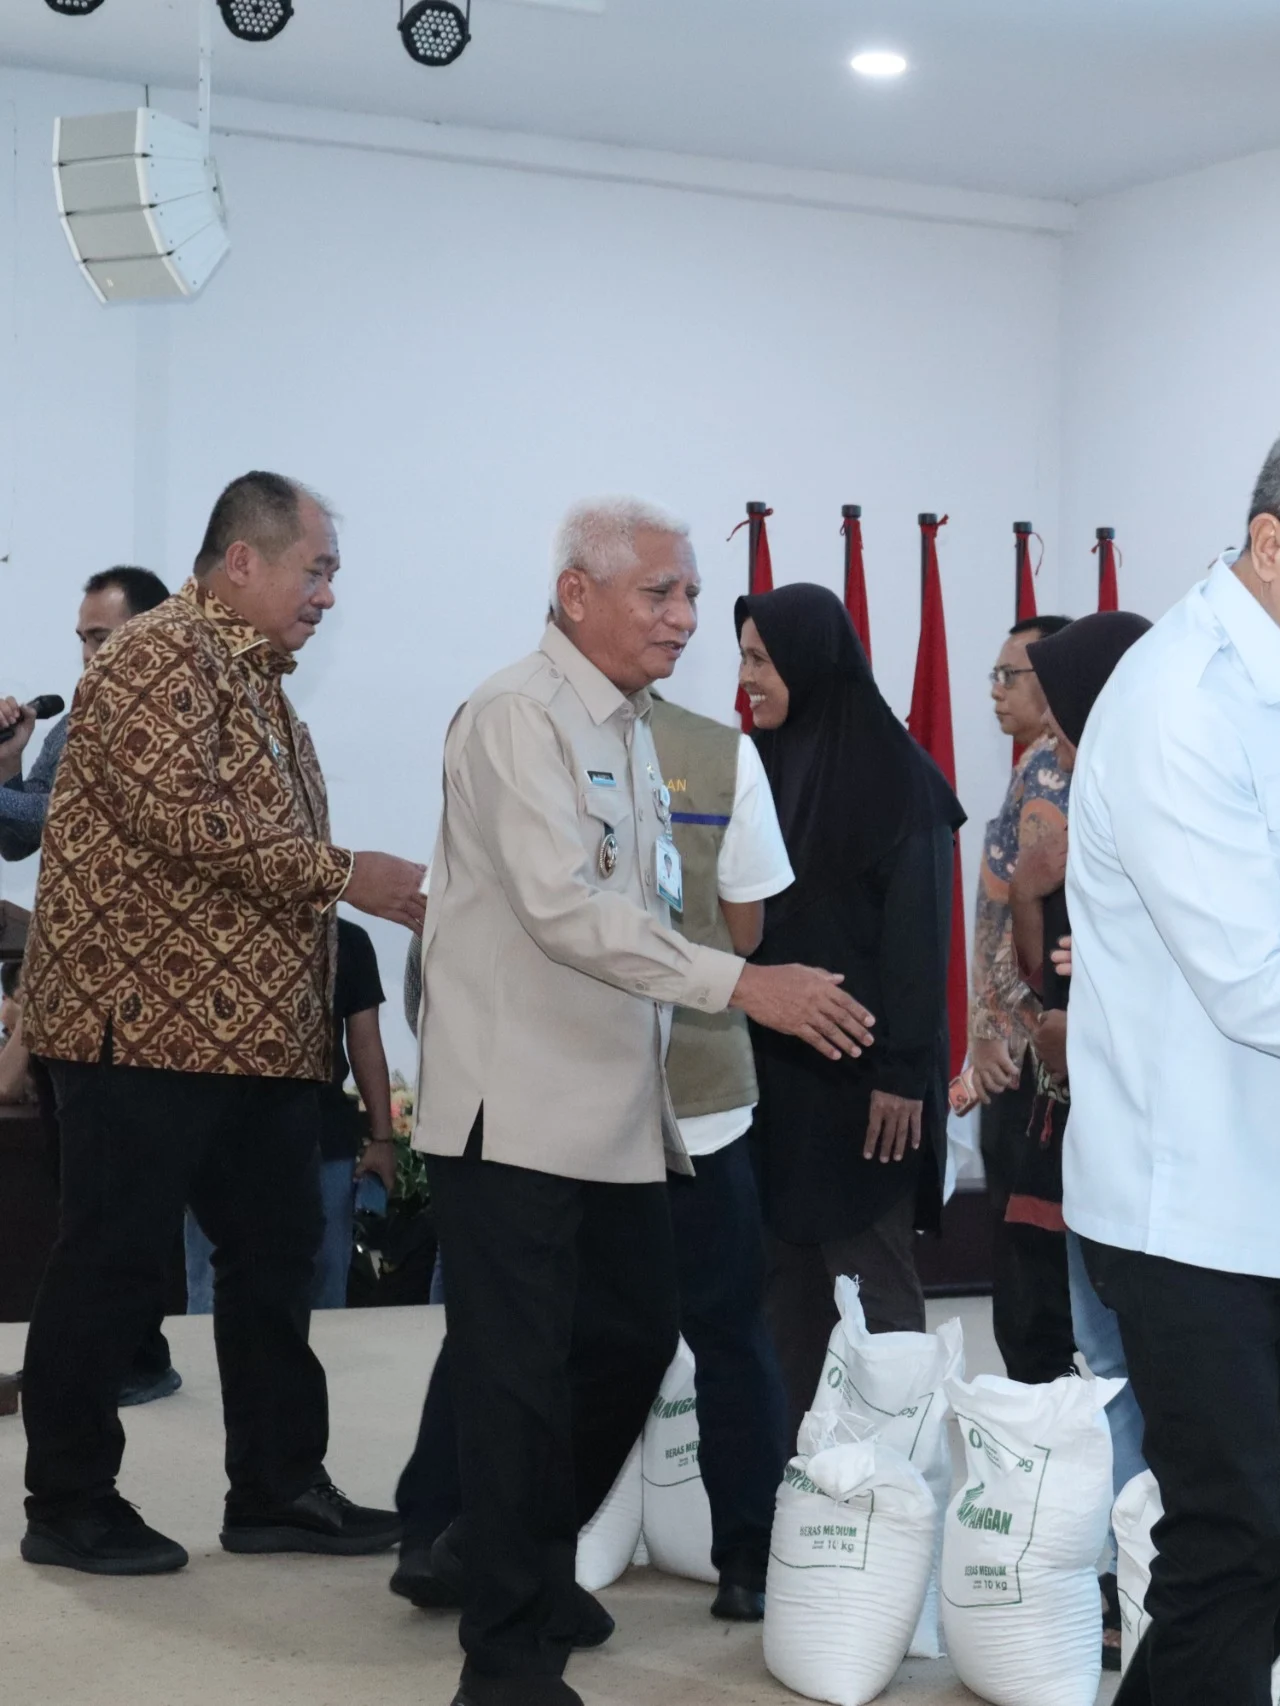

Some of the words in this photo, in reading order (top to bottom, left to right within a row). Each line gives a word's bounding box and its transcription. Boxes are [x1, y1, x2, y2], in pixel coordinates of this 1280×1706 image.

[823, 1525, 858, 1538] MEDIUM
[841, 1539, 855, 1553] kg
[984, 1579, 994, 1590] 10
[995, 1579, 1008, 1591] kg
